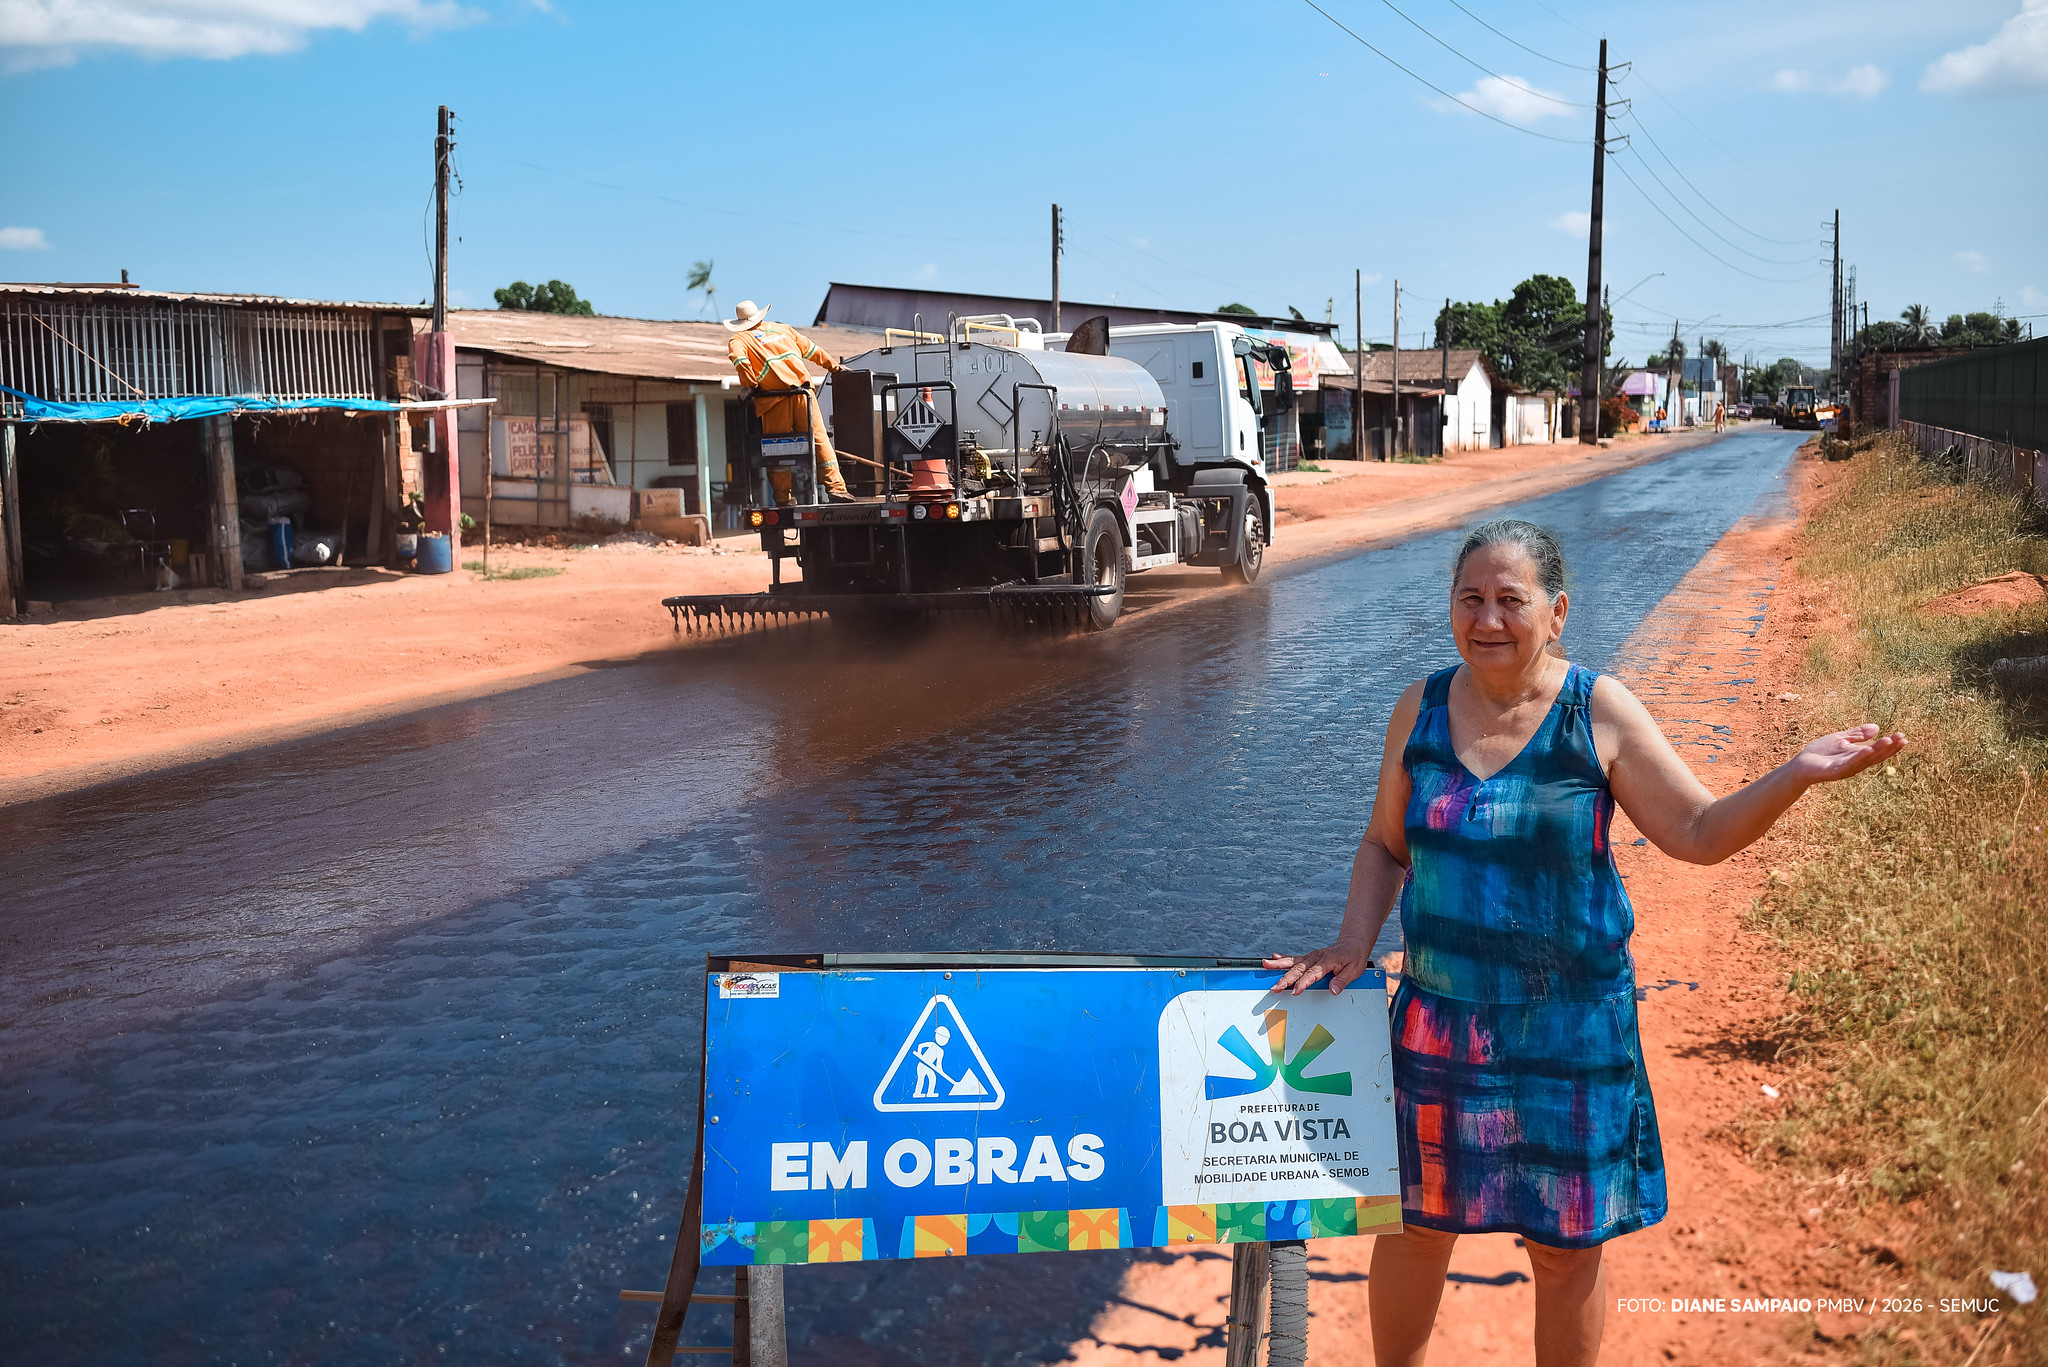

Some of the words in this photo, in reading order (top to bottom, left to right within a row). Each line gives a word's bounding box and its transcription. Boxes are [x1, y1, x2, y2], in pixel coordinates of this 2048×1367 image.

[1240, 1103, 1306, 1114] PREFEITURA
[1307, 1103, 1320, 1111] DE
[1210, 1120, 1268, 1144] BOA
[1274, 1118, 1351, 1141] VISTA
[771, 1140, 868, 1191] EM
[883, 1133, 1106, 1188] OBRAS
[1203, 1154, 1277, 1167] SECRETARIA
[1280, 1152, 1341, 1164] MUNICIPAL
[1344, 1151, 1359, 1161] DE
[1194, 1171, 1267, 1184] MOBILIDADE
[1270, 1169, 1320, 1181] URBANA
[1329, 1167, 1370, 1178] SEMOB
